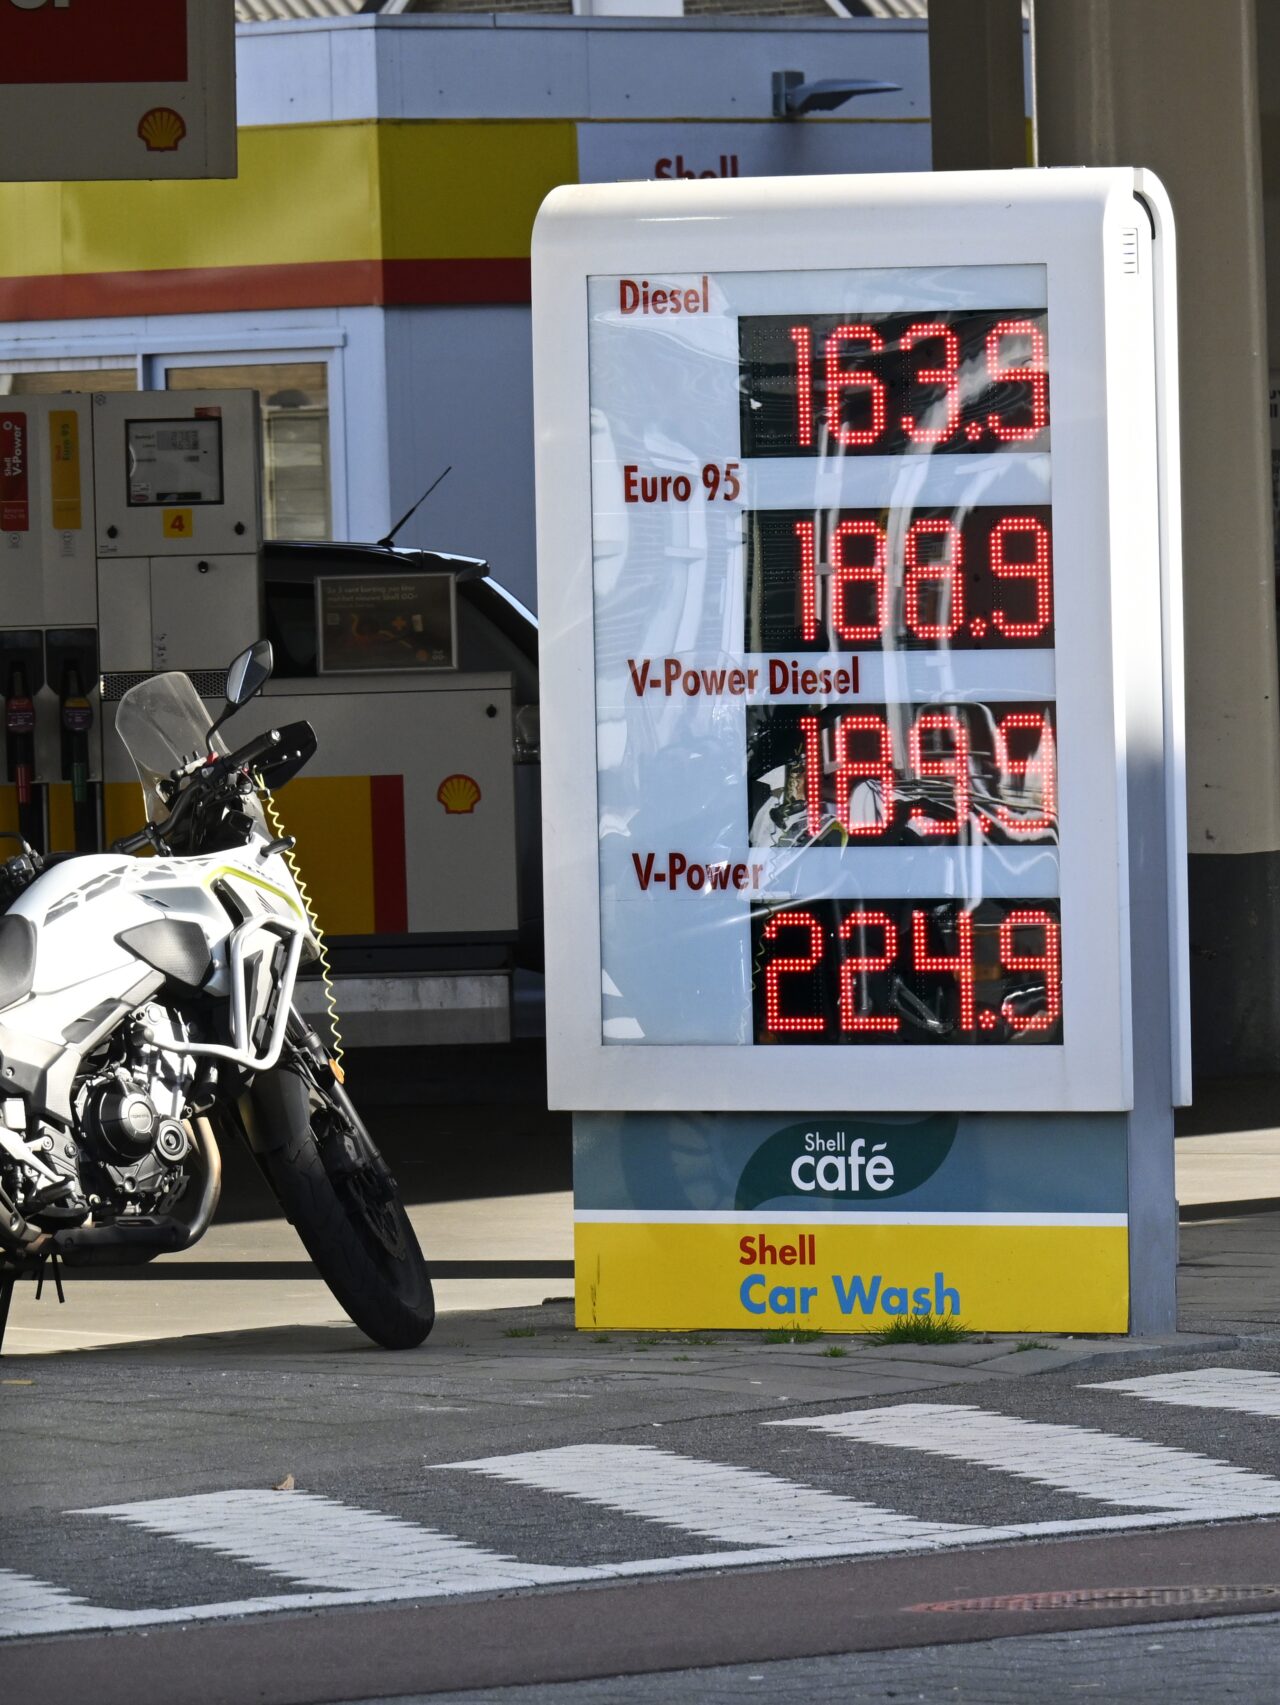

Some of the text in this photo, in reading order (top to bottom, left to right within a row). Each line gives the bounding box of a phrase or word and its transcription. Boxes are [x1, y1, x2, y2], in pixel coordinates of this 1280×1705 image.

[619, 275, 709, 315] Diesel
[789, 319, 1047, 447] 163.9
[3, 457, 12, 478] Shell
[12, 424, 23, 477] V-Power
[624, 462, 741, 504] Euro 95
[170, 515, 186, 532] 4
[793, 515, 1051, 642] 188.9
[627, 655, 860, 698] V-Power Diesel
[799, 714, 1057, 837] 189.9
[631, 852, 764, 891] V-Power
[764, 909, 1060, 1031] 224.9
[804, 1131, 846, 1152] Shell
[790, 1137, 895, 1192] café
[739, 1233, 816, 1266] Shell
[739, 1272, 961, 1316] Car Wash
